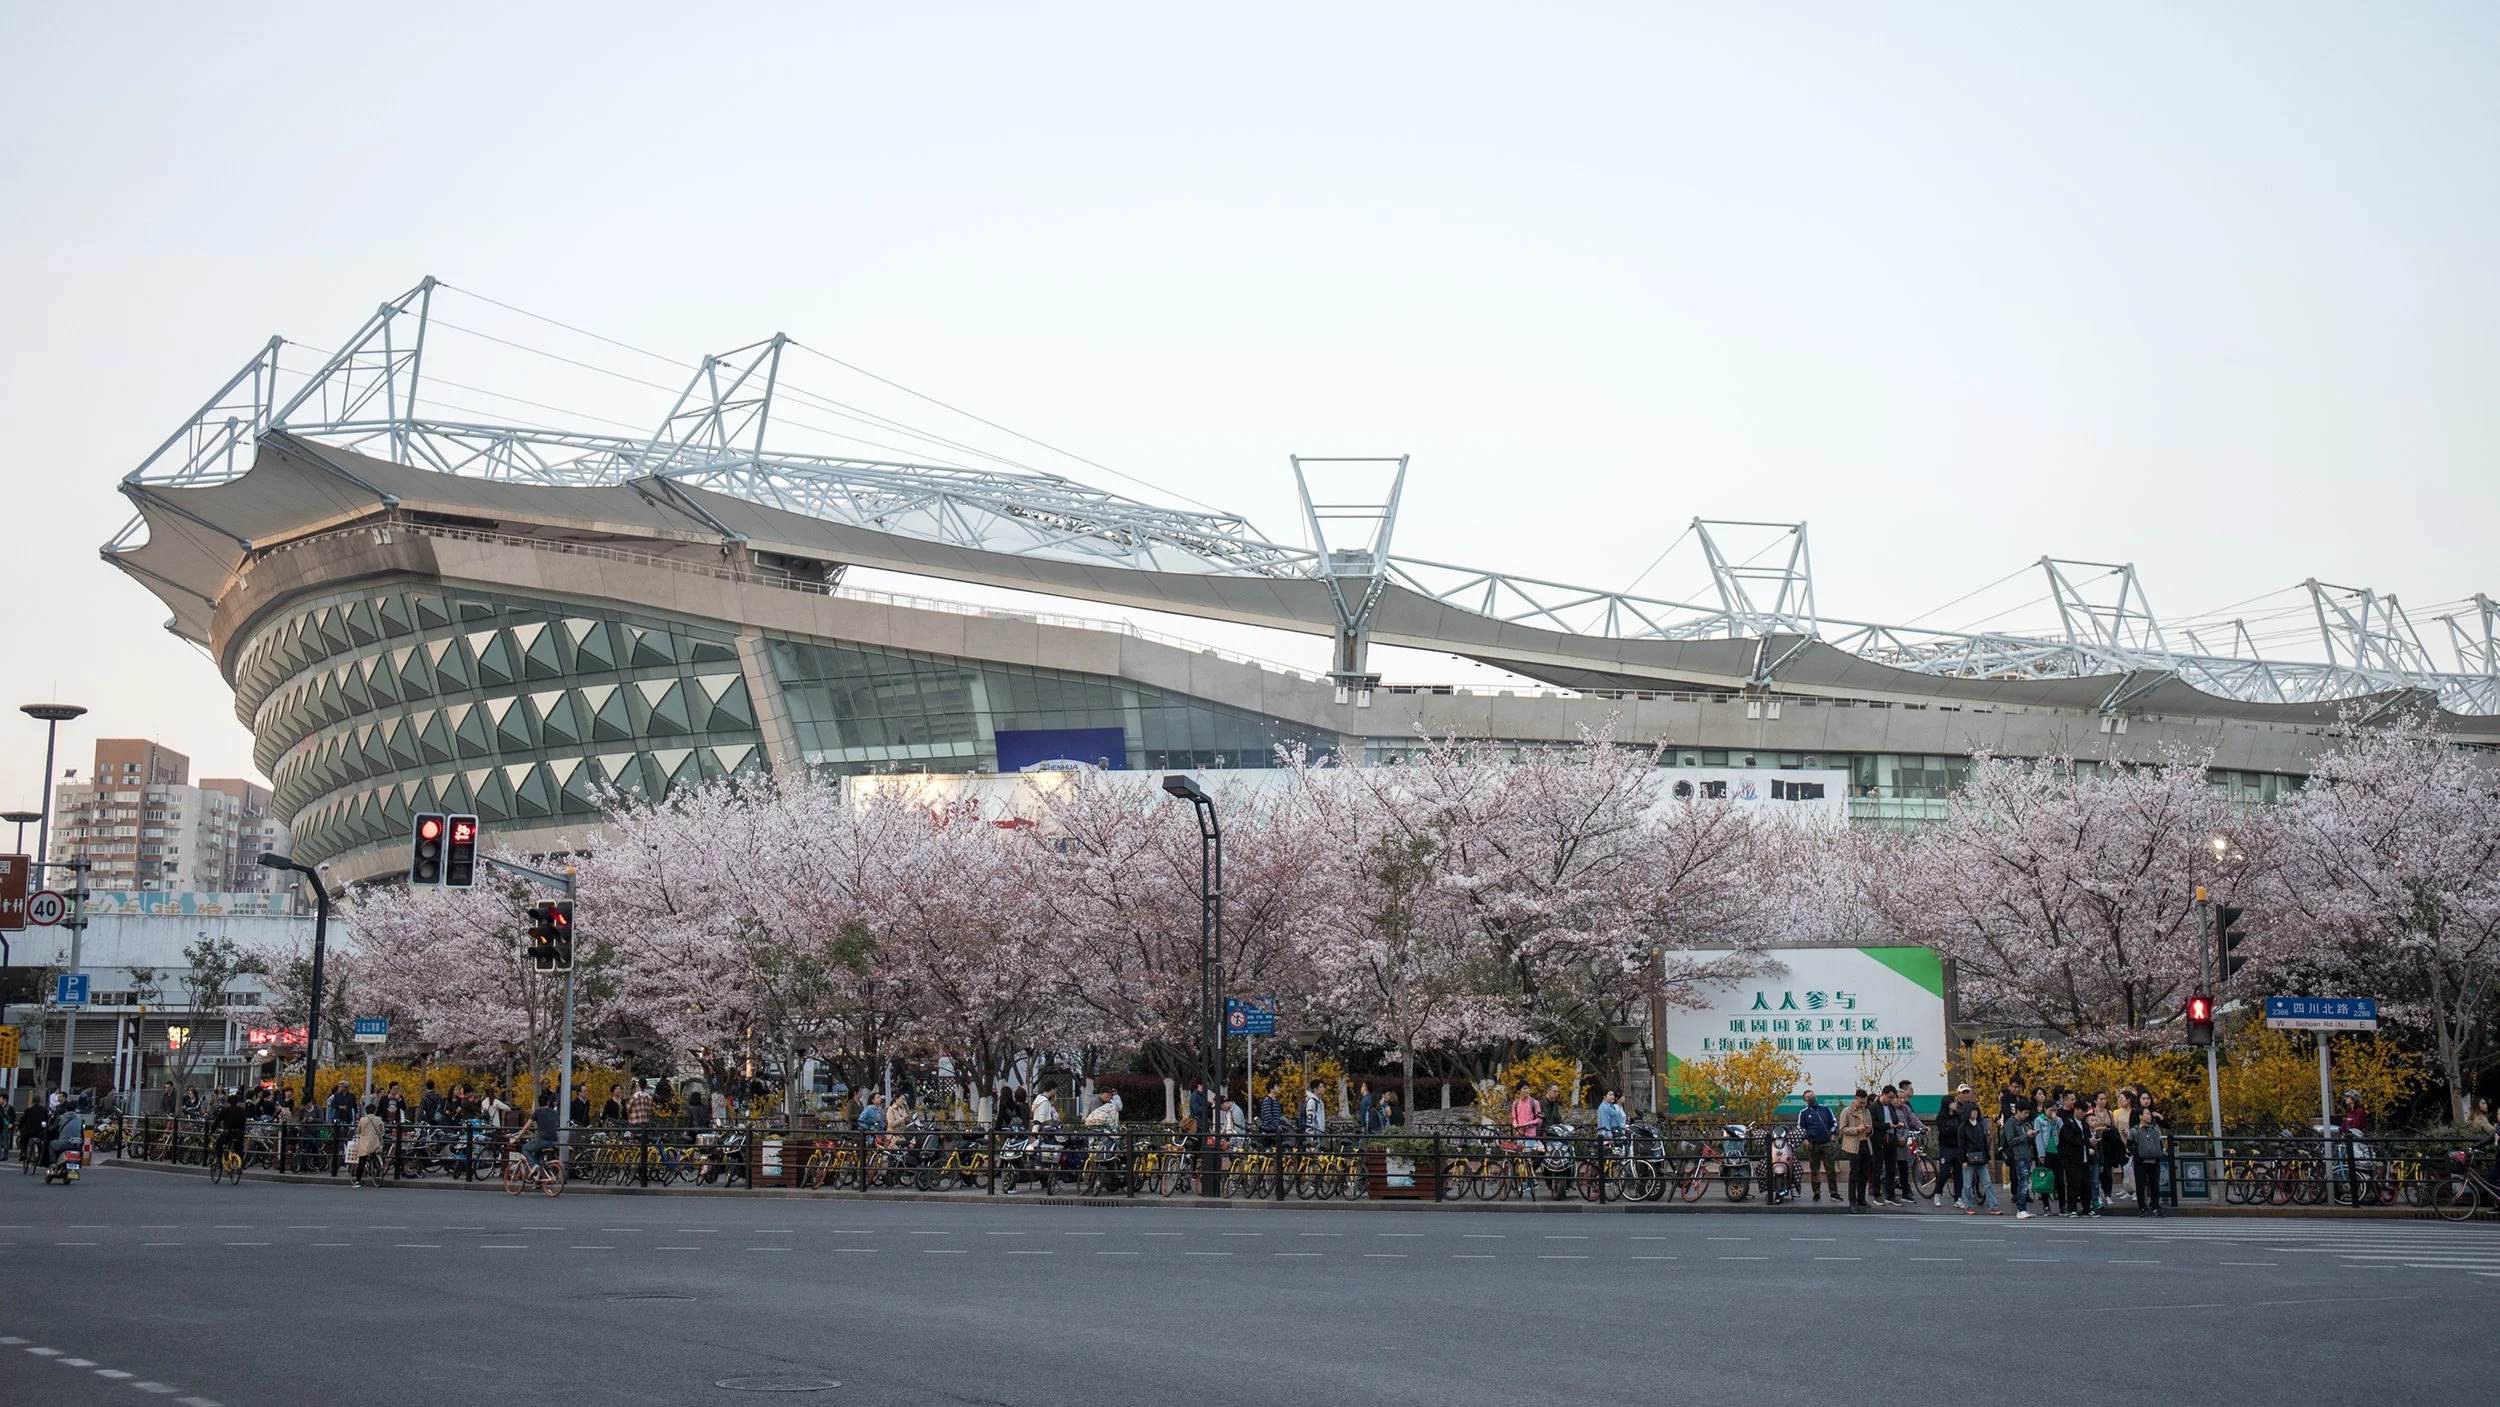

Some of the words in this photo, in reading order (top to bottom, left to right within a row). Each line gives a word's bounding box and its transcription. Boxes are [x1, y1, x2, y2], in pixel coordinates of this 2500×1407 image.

[1044, 763, 1078, 771] HENHUA
[34, 900, 57, 916] 40
[67, 977, 79, 989] P
[1751, 991, 1857, 1011] 人人参与
[2358, 1002, 2366, 1010] 东
[2272, 1008, 2289, 1016] 2388
[2293, 1002, 2349, 1015] 四川北路
[1729, 1018, 1878, 1033] 巩固国家卫生区
